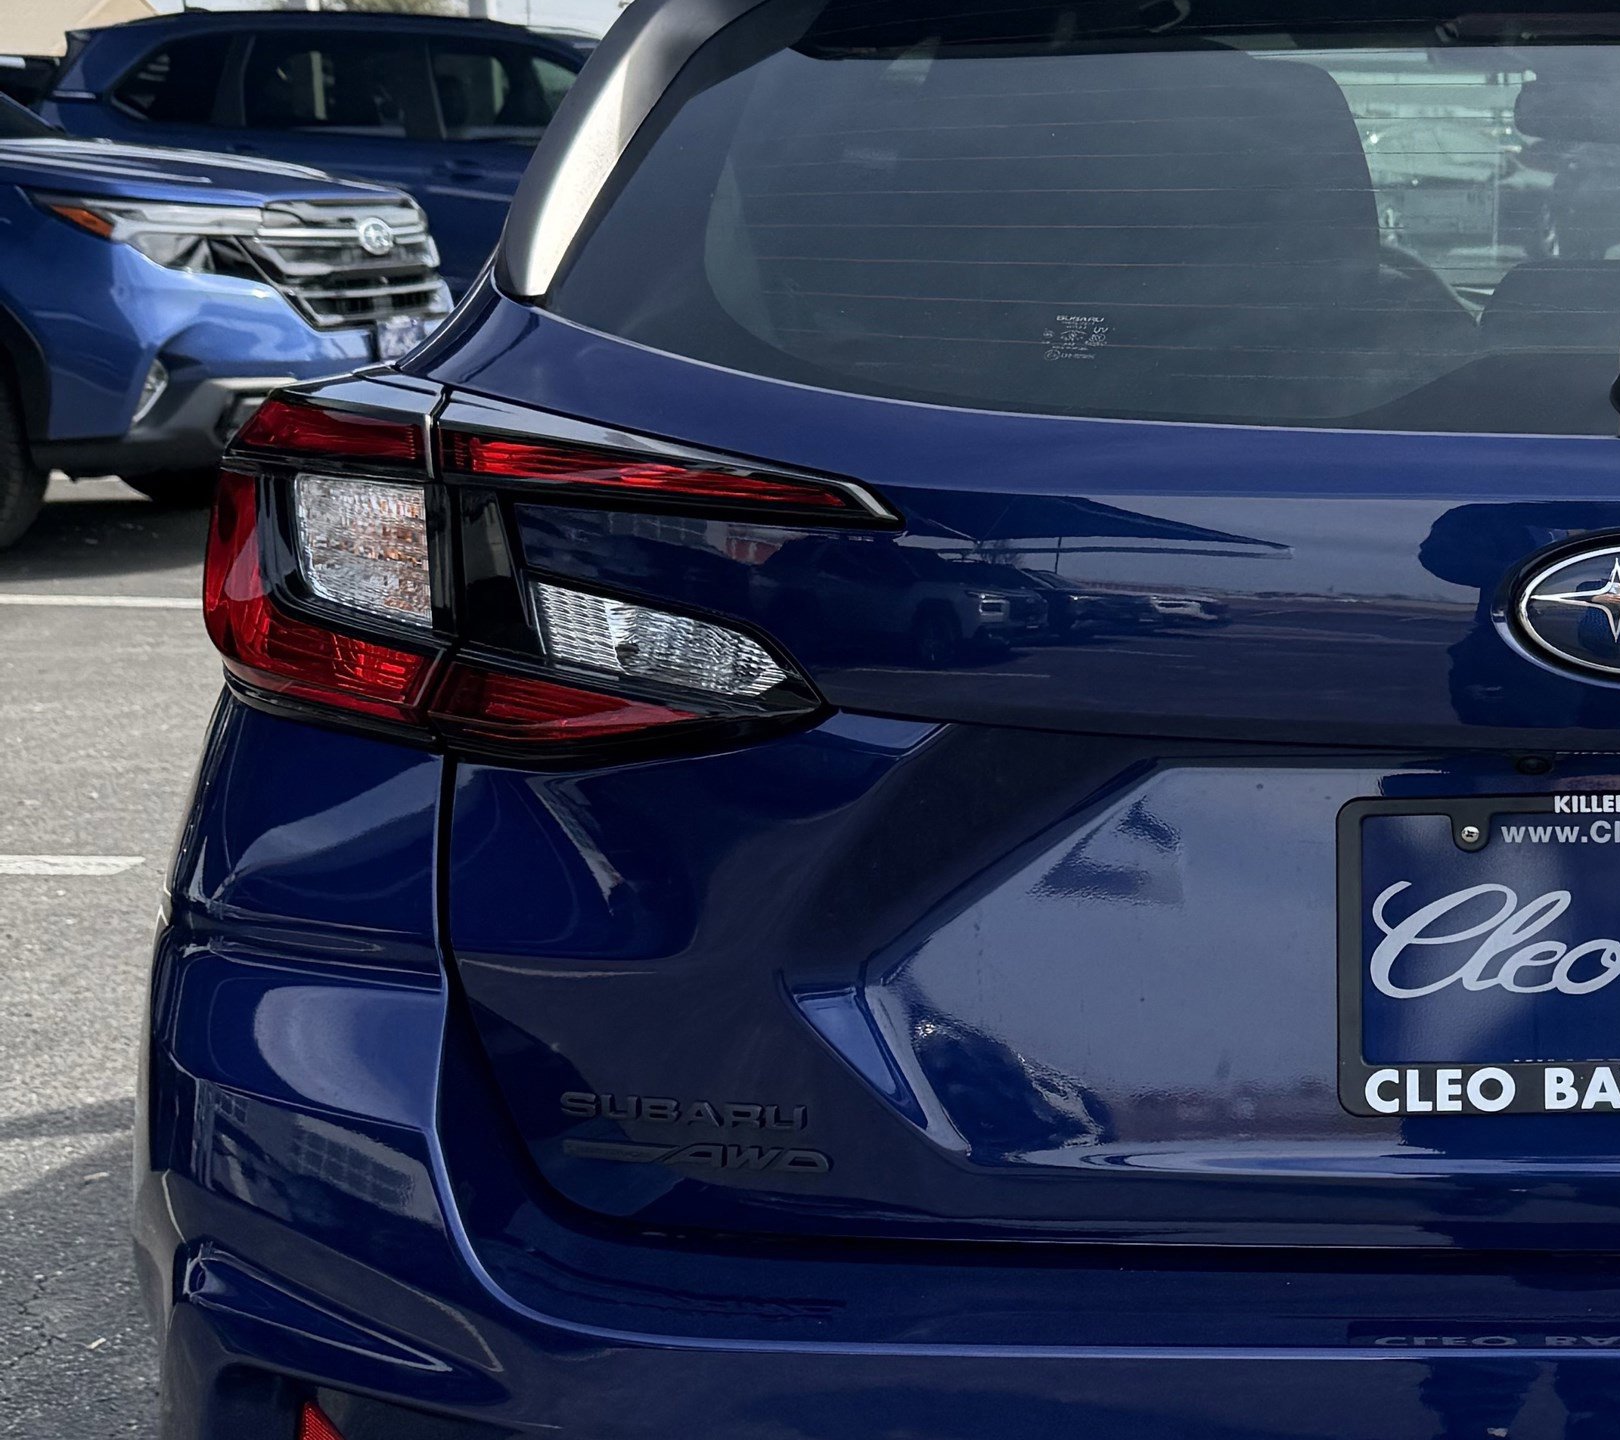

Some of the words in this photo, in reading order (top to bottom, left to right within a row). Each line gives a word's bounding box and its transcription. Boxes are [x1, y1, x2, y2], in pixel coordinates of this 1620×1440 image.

[1365, 1067, 1516, 1113] CLEO
[560, 1091, 807, 1130] SUBARU
[655, 1143, 833, 1173] AWD
